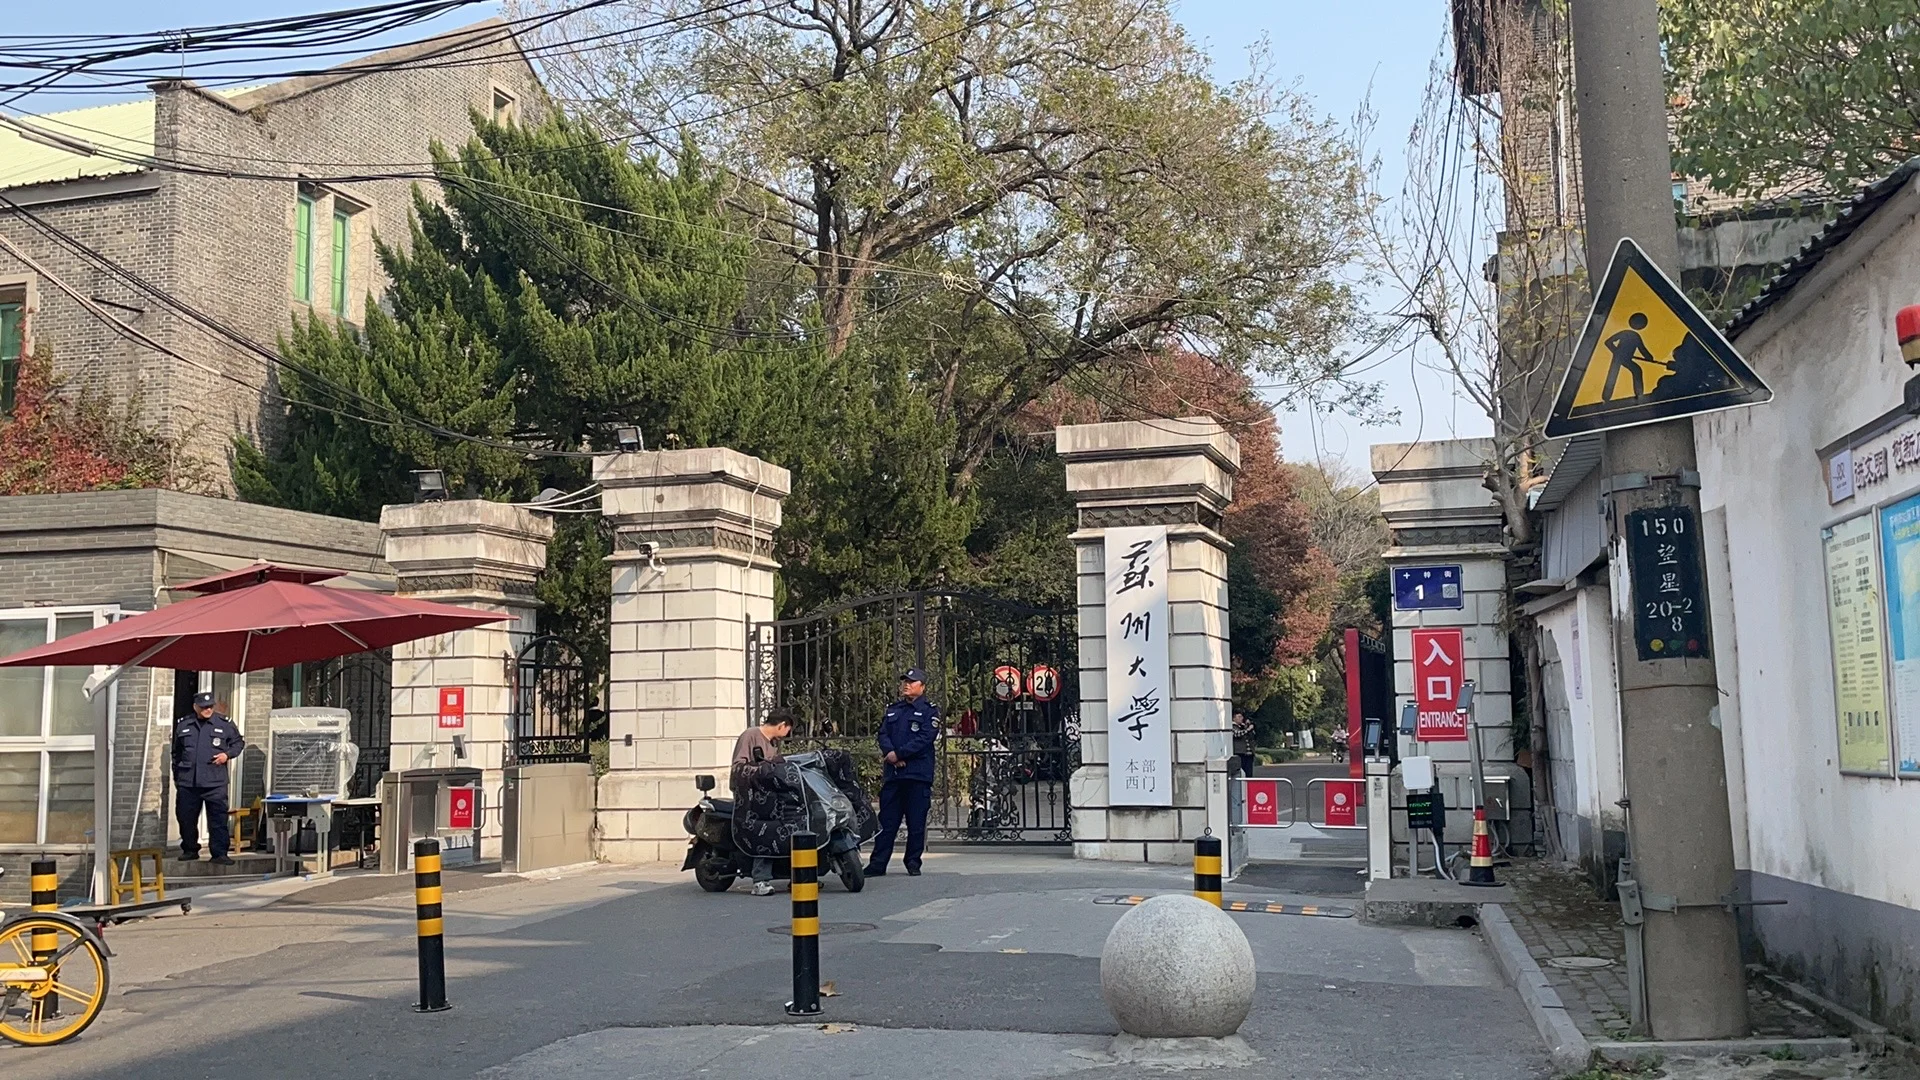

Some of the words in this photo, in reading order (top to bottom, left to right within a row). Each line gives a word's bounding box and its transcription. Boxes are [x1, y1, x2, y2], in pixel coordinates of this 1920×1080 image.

[1641, 517, 1684, 536] 150
[1415, 584, 1424, 600] 1
[1671, 616, 1683, 632] 8
[1423, 637, 1454, 701] 入口
[1419, 711, 1463, 729] ENTRANCE
[1125, 758, 1156, 774] 本部
[1125, 775, 1156, 792] 西门
